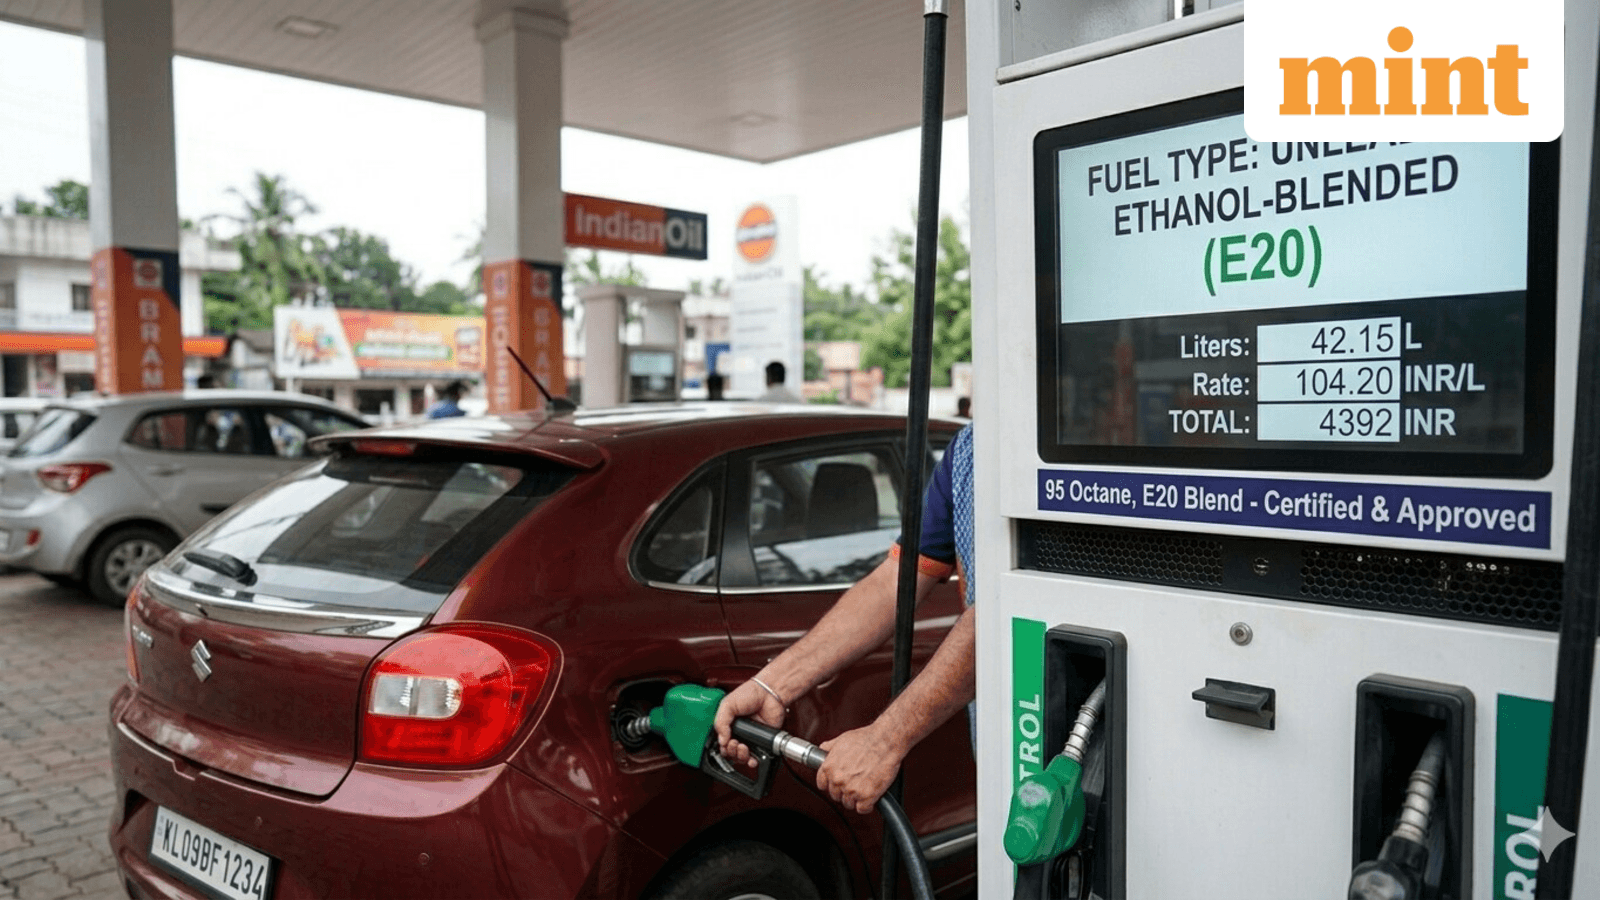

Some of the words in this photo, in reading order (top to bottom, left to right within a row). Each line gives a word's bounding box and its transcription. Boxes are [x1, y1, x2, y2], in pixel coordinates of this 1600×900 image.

[1088, 156, 1160, 196] FUEL
[1167, 137, 1258, 182] TYPE:
[1114, 154, 1459, 236] ETHANOL-BLENDED
[1203, 225, 1323, 297] (E20)
[1180, 334, 1250, 359] Liters:
[1311, 323, 1394, 355] 42.15
[1405, 322, 1423, 350] L
[1193, 372, 1250, 396] Rate:
[1296, 366, 1393, 396] 104.20
[1405, 362, 1486, 393] INR/L
[1168, 409, 1250, 434] TOTAL:
[1319, 408, 1393, 437] 4392
[1405, 408, 1457, 436] INR
[1045, 479, 1065, 501] 95
[1069, 480, 1137, 509] Octane,
[1143, 484, 1178, 508] E20
[1184, 485, 1244, 512] Blend
[1250, 499, 1259, 508] -
[1264, 489, 1363, 521] Certified
[1370, 495, 1390, 522] &
[1396, 497, 1537, 533] Approved
[162, 818, 266, 900] KL09BF1234
